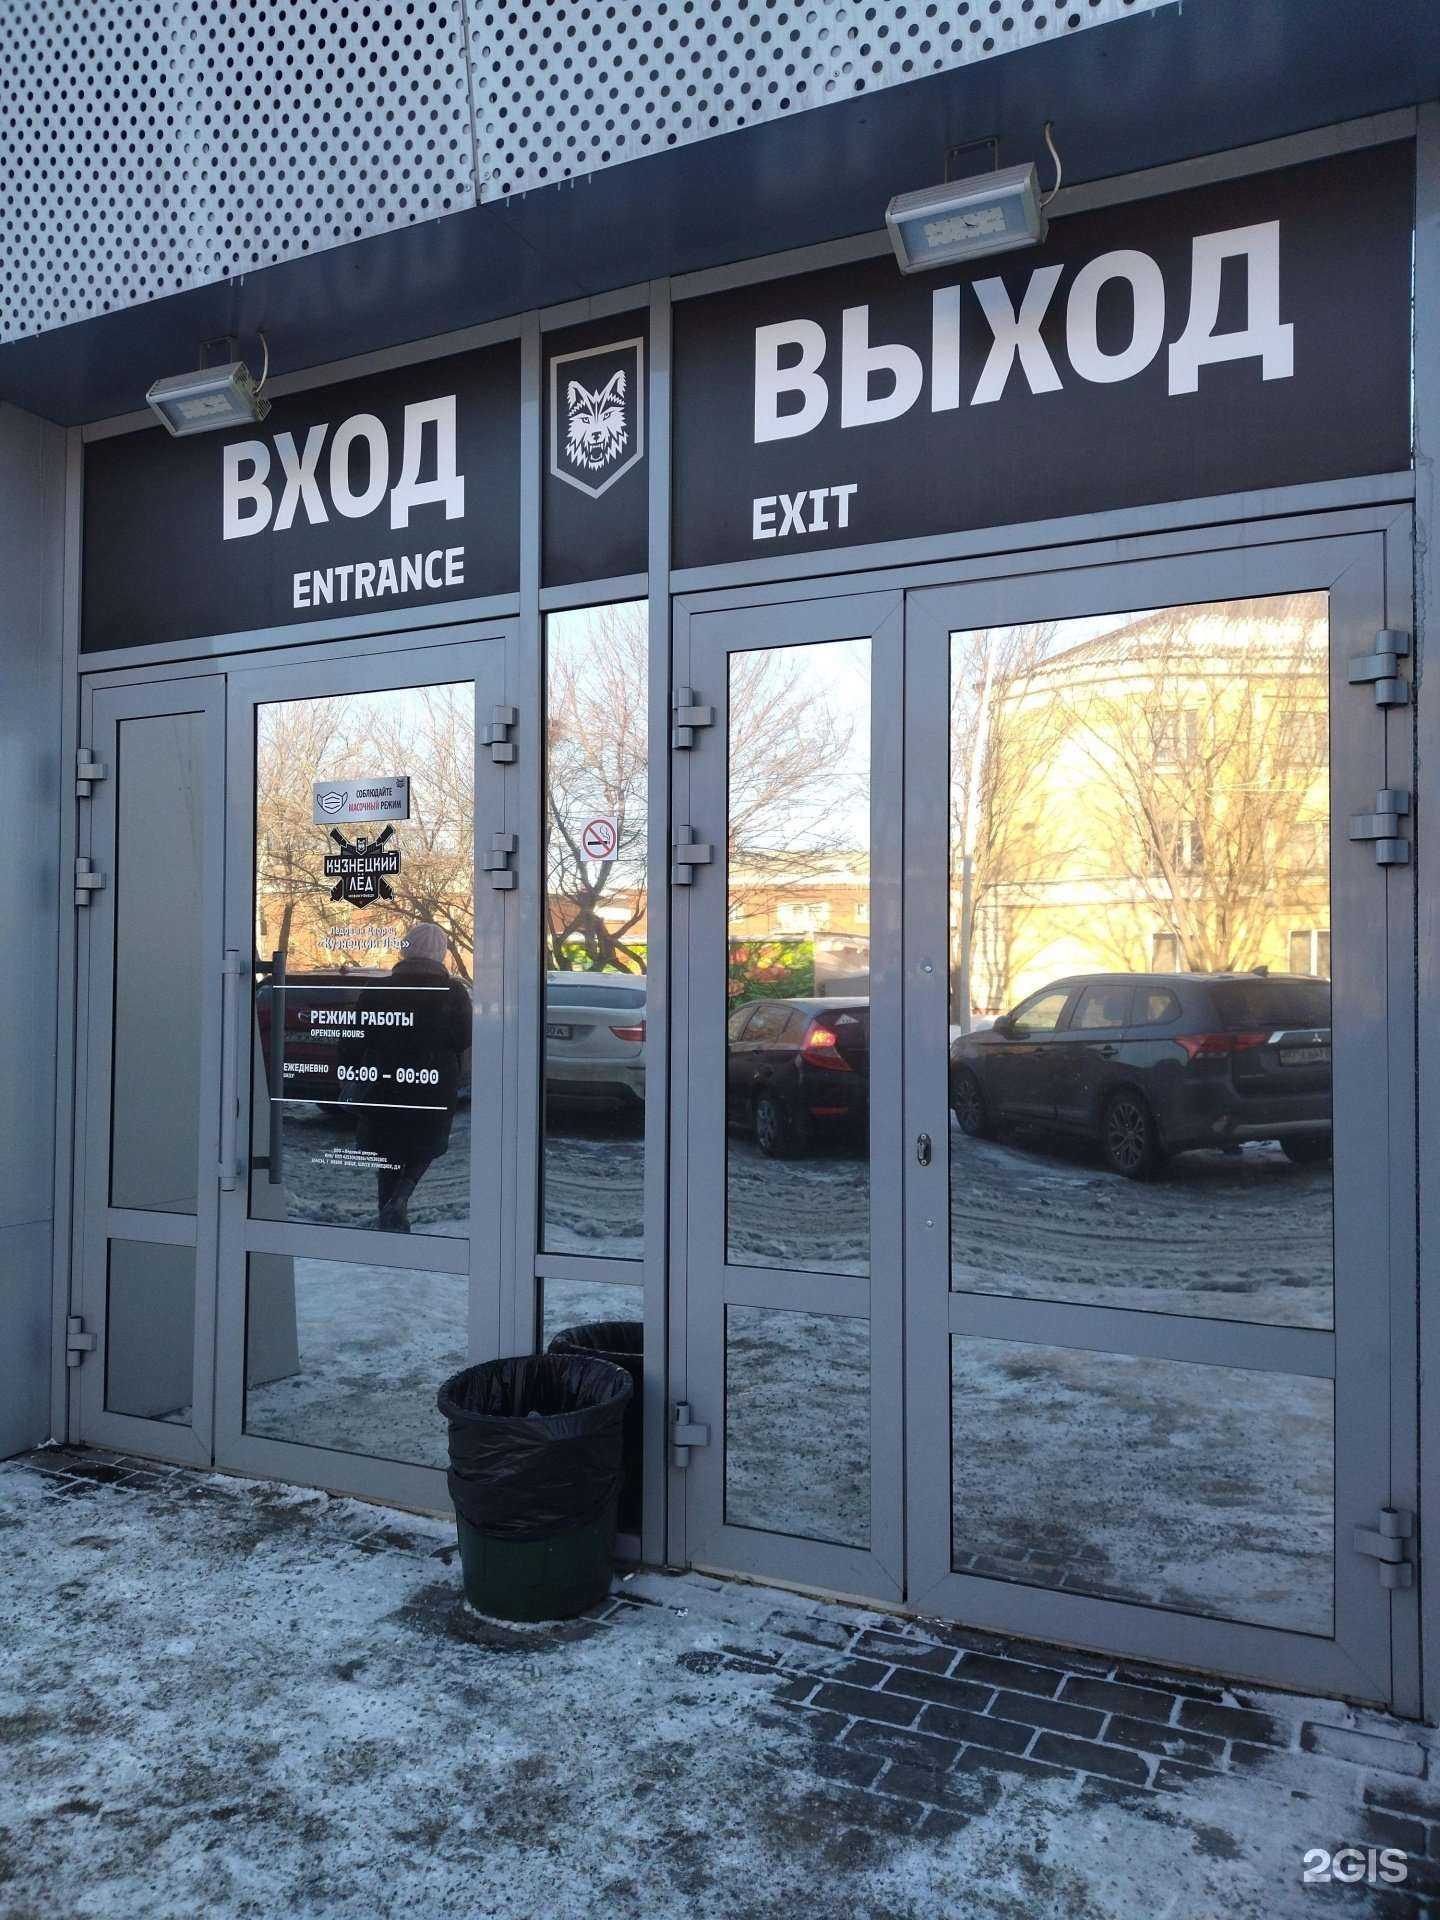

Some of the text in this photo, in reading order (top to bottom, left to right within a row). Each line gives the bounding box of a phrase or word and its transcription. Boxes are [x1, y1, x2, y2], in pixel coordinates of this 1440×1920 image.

[754, 220, 1294, 443] ВЫХОД
[222, 394, 464, 540] ВХОД
[753, 483, 857, 540] EXIT
[292, 546, 465, 608] ENTRANCE
[356, 786, 393, 799] СОБЛЮДАЙТЕ
[348, 798, 402, 812] МАСОЧНЫЙ РЕЖИМ
[326, 853, 398, 873] КУЗНЕЦКИЙ
[349, 873, 374, 892] ЛЁД
[310, 1010, 414, 1027] РЕЖИМ РАБОТЫ
[310, 1029, 365, 1038] OPENING HOURS
[283, 1062, 329, 1073] ЕЖЕДНЕВНО
[336, 1065, 378, 1082] 06:00
[395, 1068, 439, 1085] 00:00
